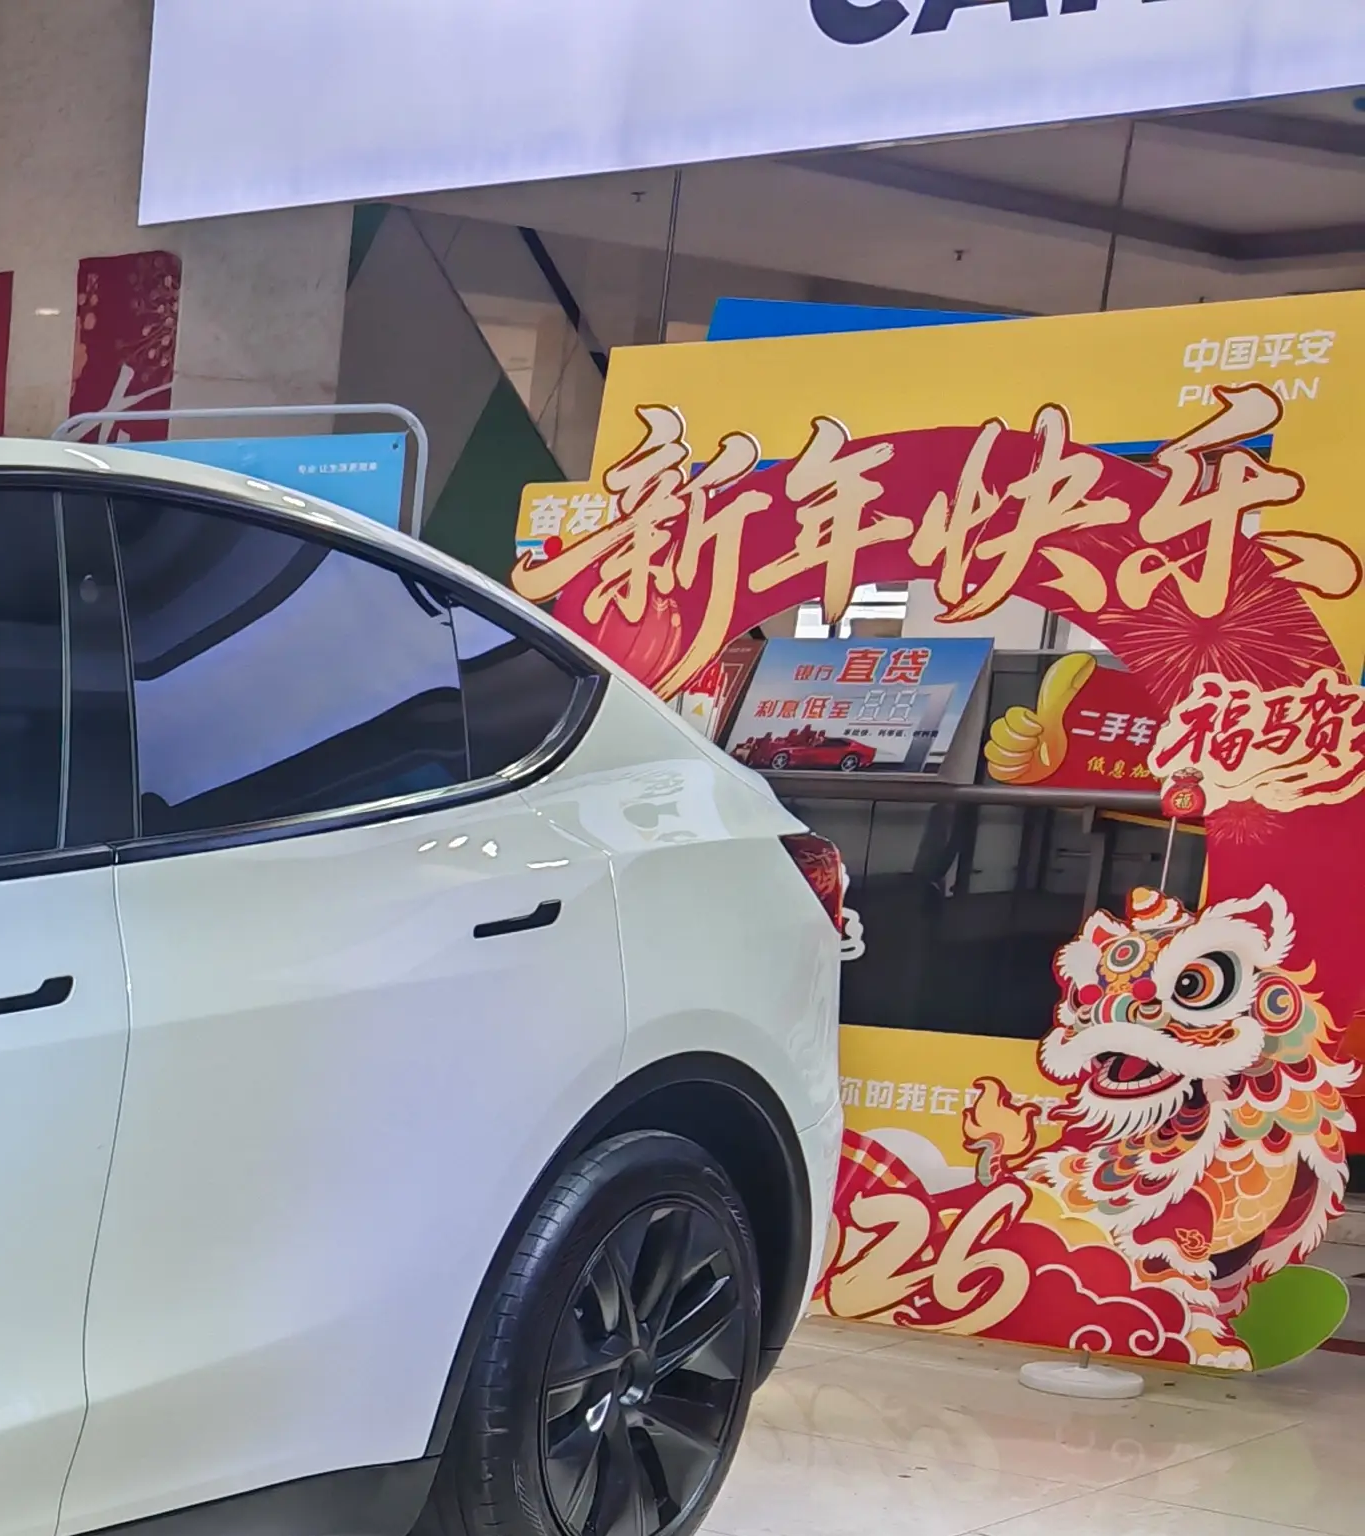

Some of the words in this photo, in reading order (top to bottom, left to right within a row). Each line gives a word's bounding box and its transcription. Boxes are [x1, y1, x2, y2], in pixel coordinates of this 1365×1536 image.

[1182, 328, 1337, 373] 中国平安
[530, 494, 620, 537] 奋发
[512, 384, 1363, 698] 新年快乐
[794, 648, 930, 683] 银行直贷
[754, 696, 852, 720] 利息低至
